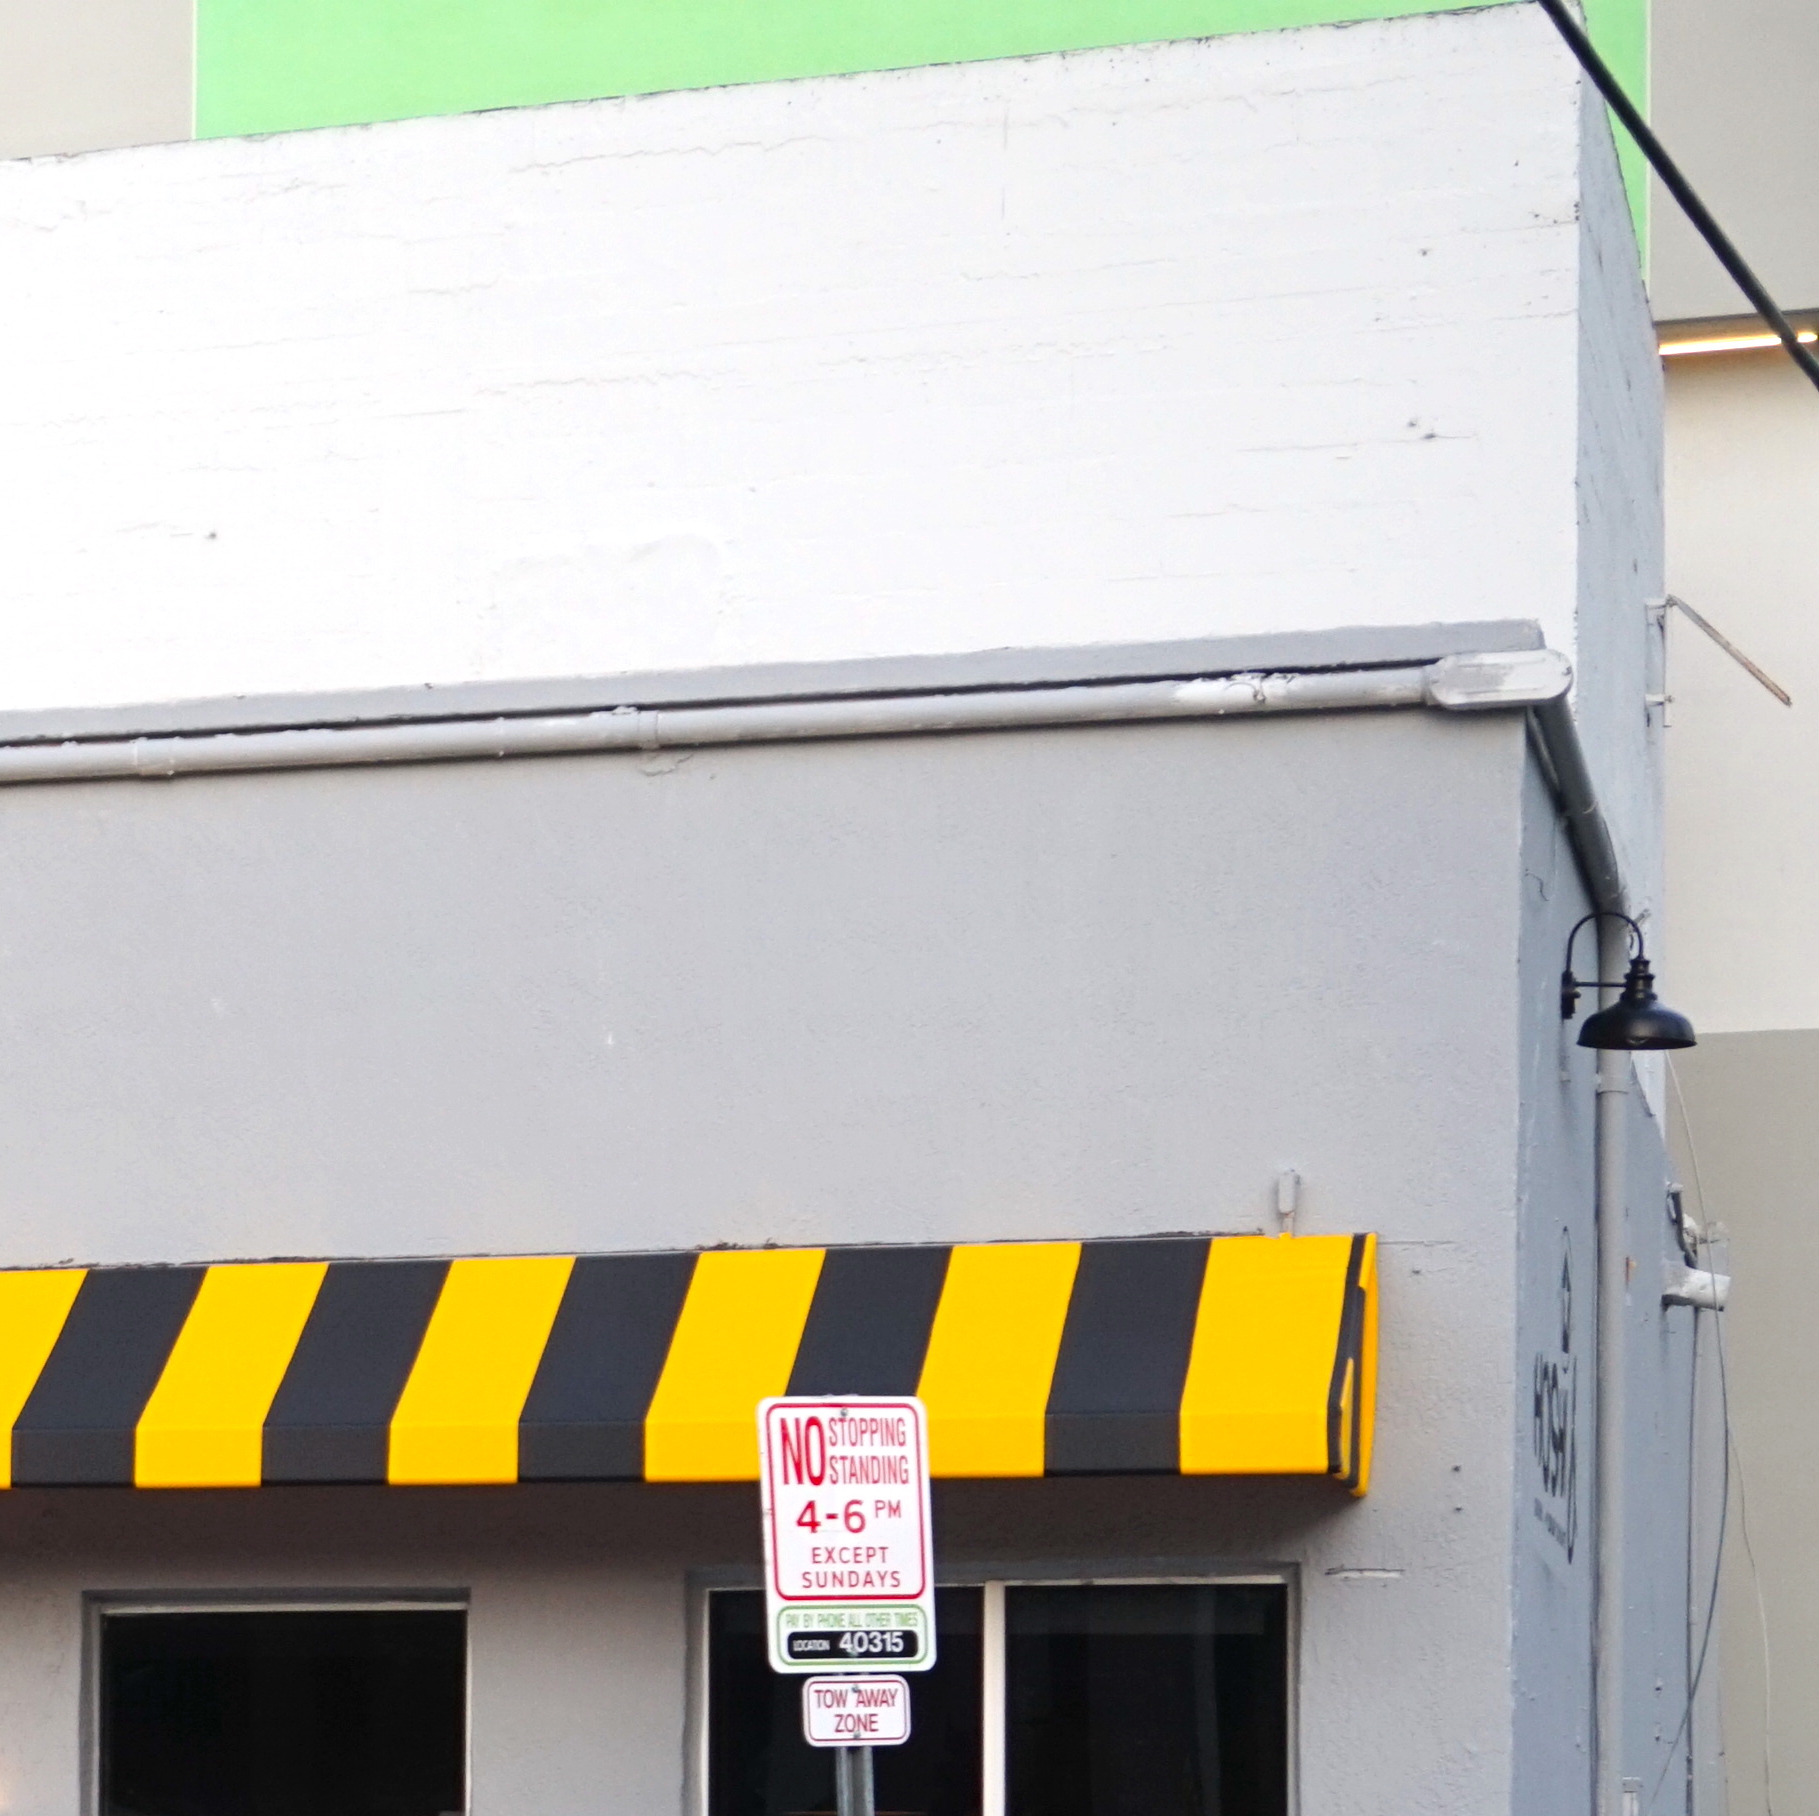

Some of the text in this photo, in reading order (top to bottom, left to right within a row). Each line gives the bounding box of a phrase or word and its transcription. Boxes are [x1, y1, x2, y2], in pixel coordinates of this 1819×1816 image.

[828, 1417, 906, 1447] STOPPING
[780, 1416, 826, 1486] NO
[829, 1455, 909, 1485] STANDING
[796, 1499, 902, 1534] 4-6 PM
[812, 1546, 889, 1564] EXCEPT
[802, 1570, 901, 1588] SUNDAYS
[817, 1613, 846, 1628] PHONE
[865, 1612, 892, 1628] OTHER
[894, 1612, 919, 1627] TIMES
[792, 1631, 905, 1653] LOCATION 40315
[813, 1688, 899, 1708] TOW AWAY
[834, 1713, 880, 1733] ZONE
